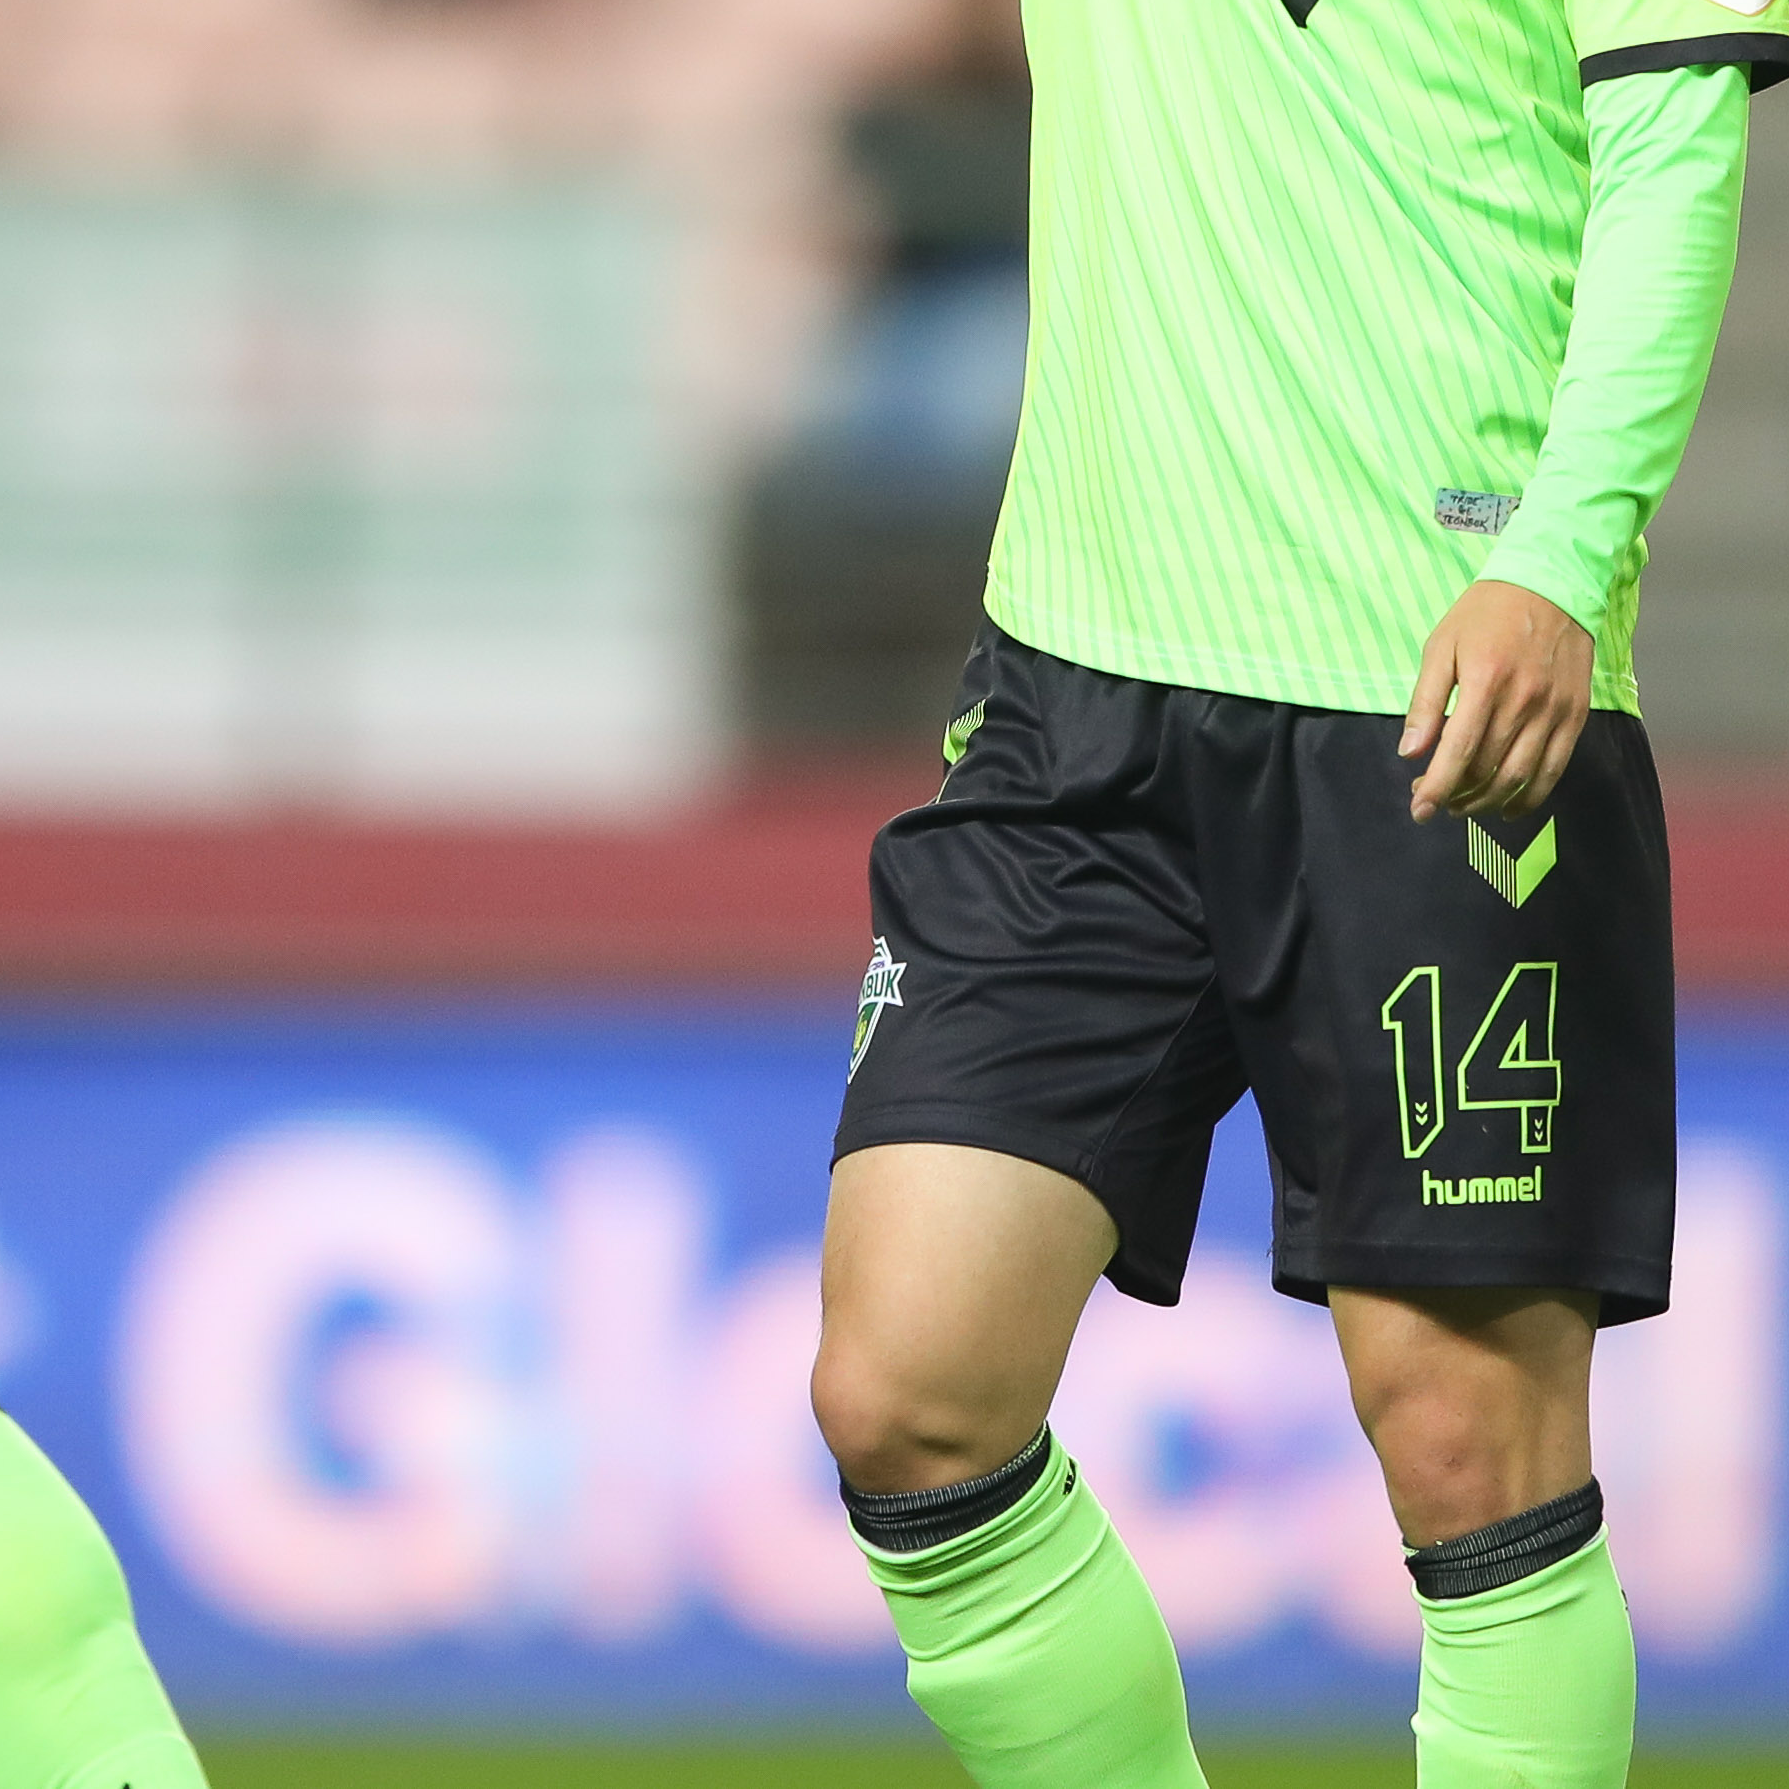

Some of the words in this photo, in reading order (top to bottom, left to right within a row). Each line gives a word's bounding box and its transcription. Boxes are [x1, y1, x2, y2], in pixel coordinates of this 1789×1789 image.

[1382, 962, 1562, 1159] 14
[1422, 1164, 1542, 1206] hummel
[117, 1109, 1786, 1647] Glocl
